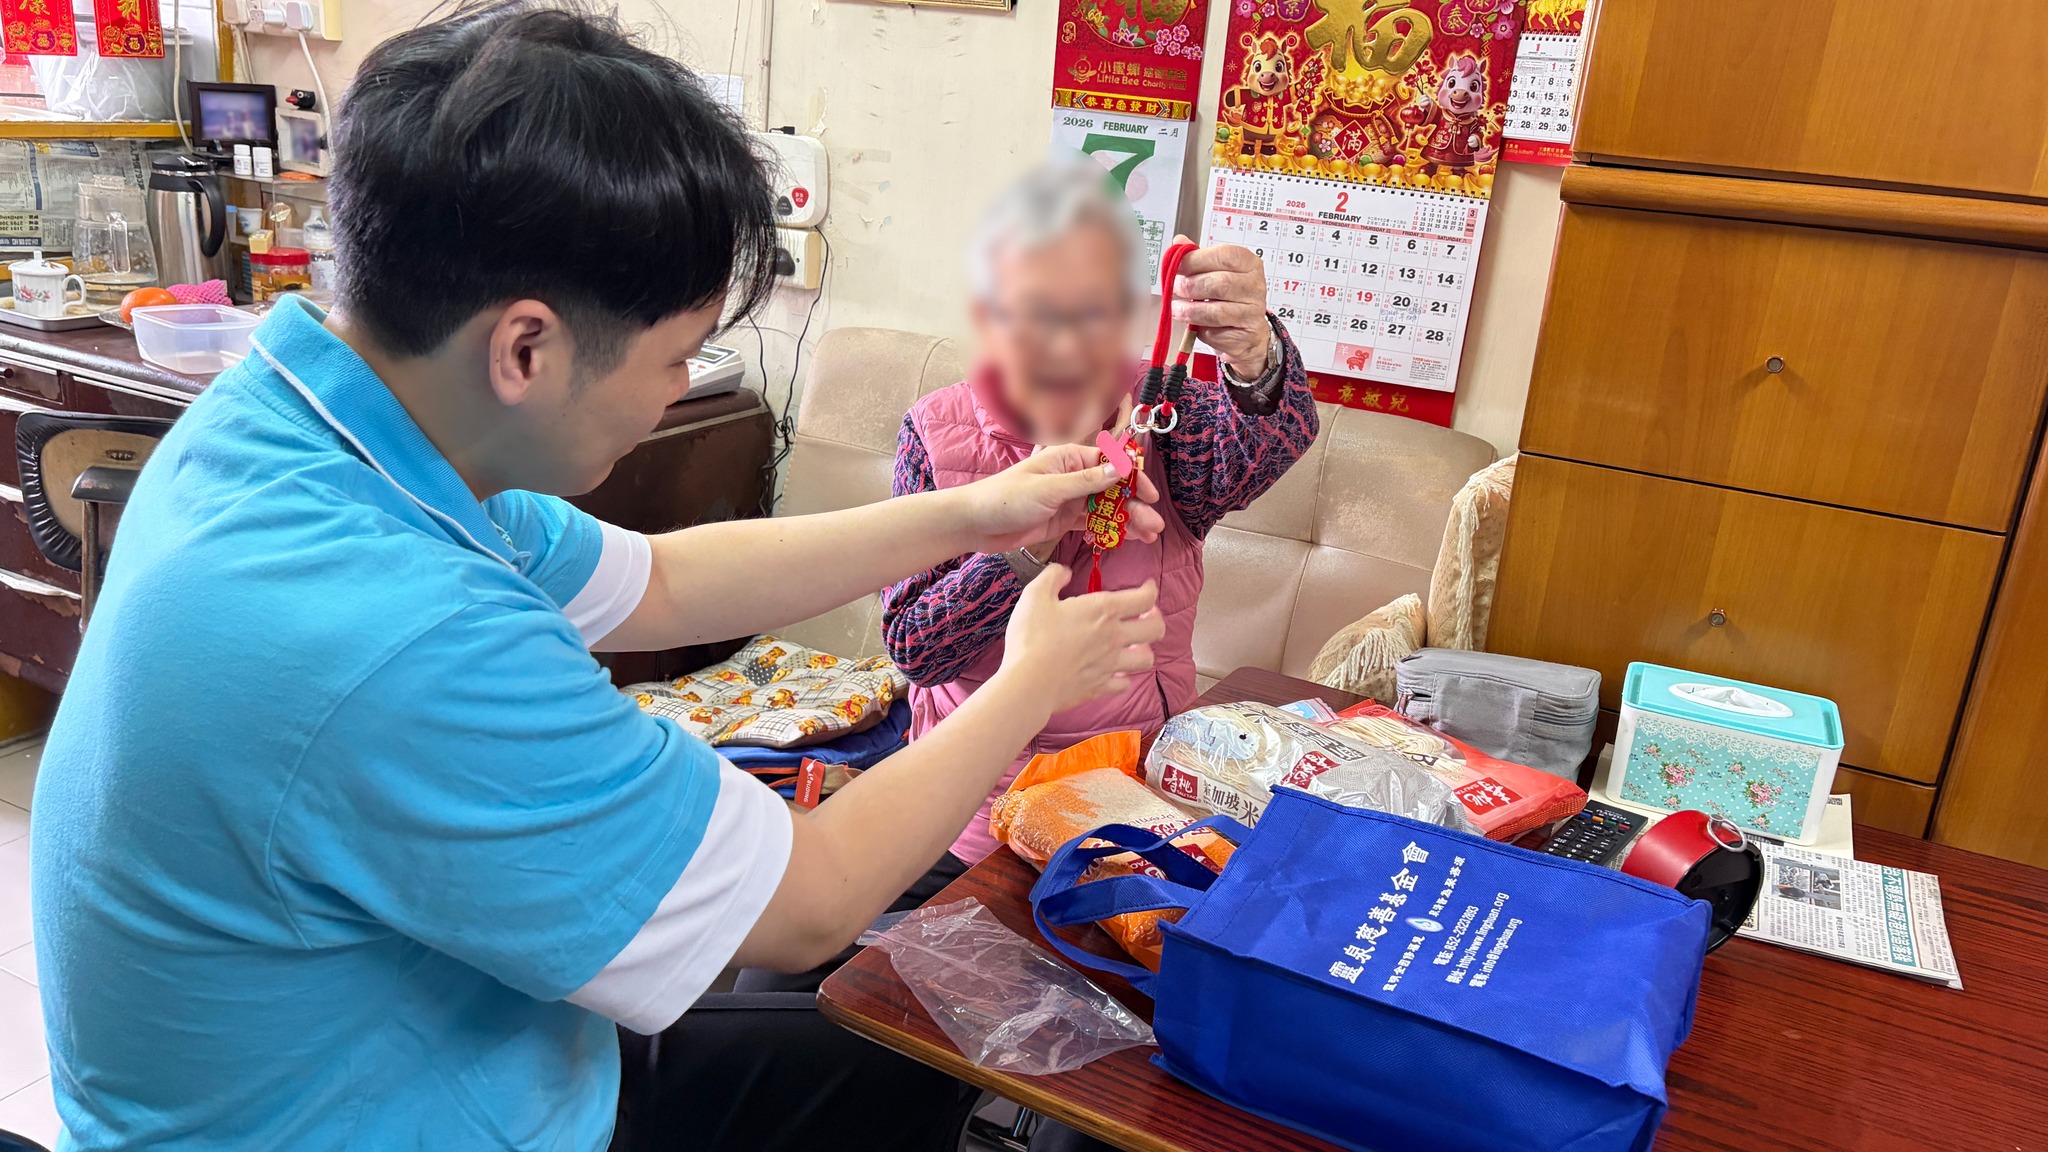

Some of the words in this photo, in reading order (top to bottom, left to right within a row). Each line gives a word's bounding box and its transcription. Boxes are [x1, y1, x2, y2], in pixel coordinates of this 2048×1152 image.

[1097, 74, 1120, 84] Little
[1122, 76, 1139, 85] Bee
[1512, 75, 1517, 83] 6
[1526, 91, 1535, 99] 14
[1544, 93, 1553, 101] 15
[1063, 117, 1093, 128] 2026
[1103, 122, 1148, 134] FEBRUARY
[1159, 127, 1179, 138] 二月
[1504, 119, 1513, 127] 27
[1538, 122, 1548, 130] 29
[1556, 124, 1567, 132] 30
[1286, 200, 1306, 208] 2026
[1335, 192, 1349, 213] 2
[1318, 212, 1361, 223] FEBRUARY
[1321, 220, 1350, 228] WEDNESDAY
[1226, 216, 1231, 226] 1
[1259, 221, 1268, 230] 2
[1295, 225, 1304, 235] 3
[1332, 230, 1340, 240] 4
[1369, 235, 1378, 245] 5
[1408, 240, 1416, 249] 6
[1446, 245, 1455, 255] 7
[1256, 248, 1263, 258] 9
[1288, 253, 1304, 263] 10
[1324, 258, 1339, 269] 11
[1361, 263, 1378, 274] 12
[1399, 268, 1416, 279] 13
[1438, 273, 1454, 285] 14
[1284, 281, 1299, 291] 17
[1320, 286, 1336, 296] 18
[1357, 291, 1373, 302] 19
[1393, 296, 1410, 307] 20
[1431, 302, 1448, 313] 21
[1278, 308, 1294, 318] 24
[1314, 314, 1331, 324] 25
[1350, 319, 1368, 330] 26
[1388, 324, 1406, 335] 27
[1425, 330, 1444, 341] 28
[1088, 478, 1128, 535] 春接福
[1329, 841, 1429, 984] 靈泉慈善基金會
